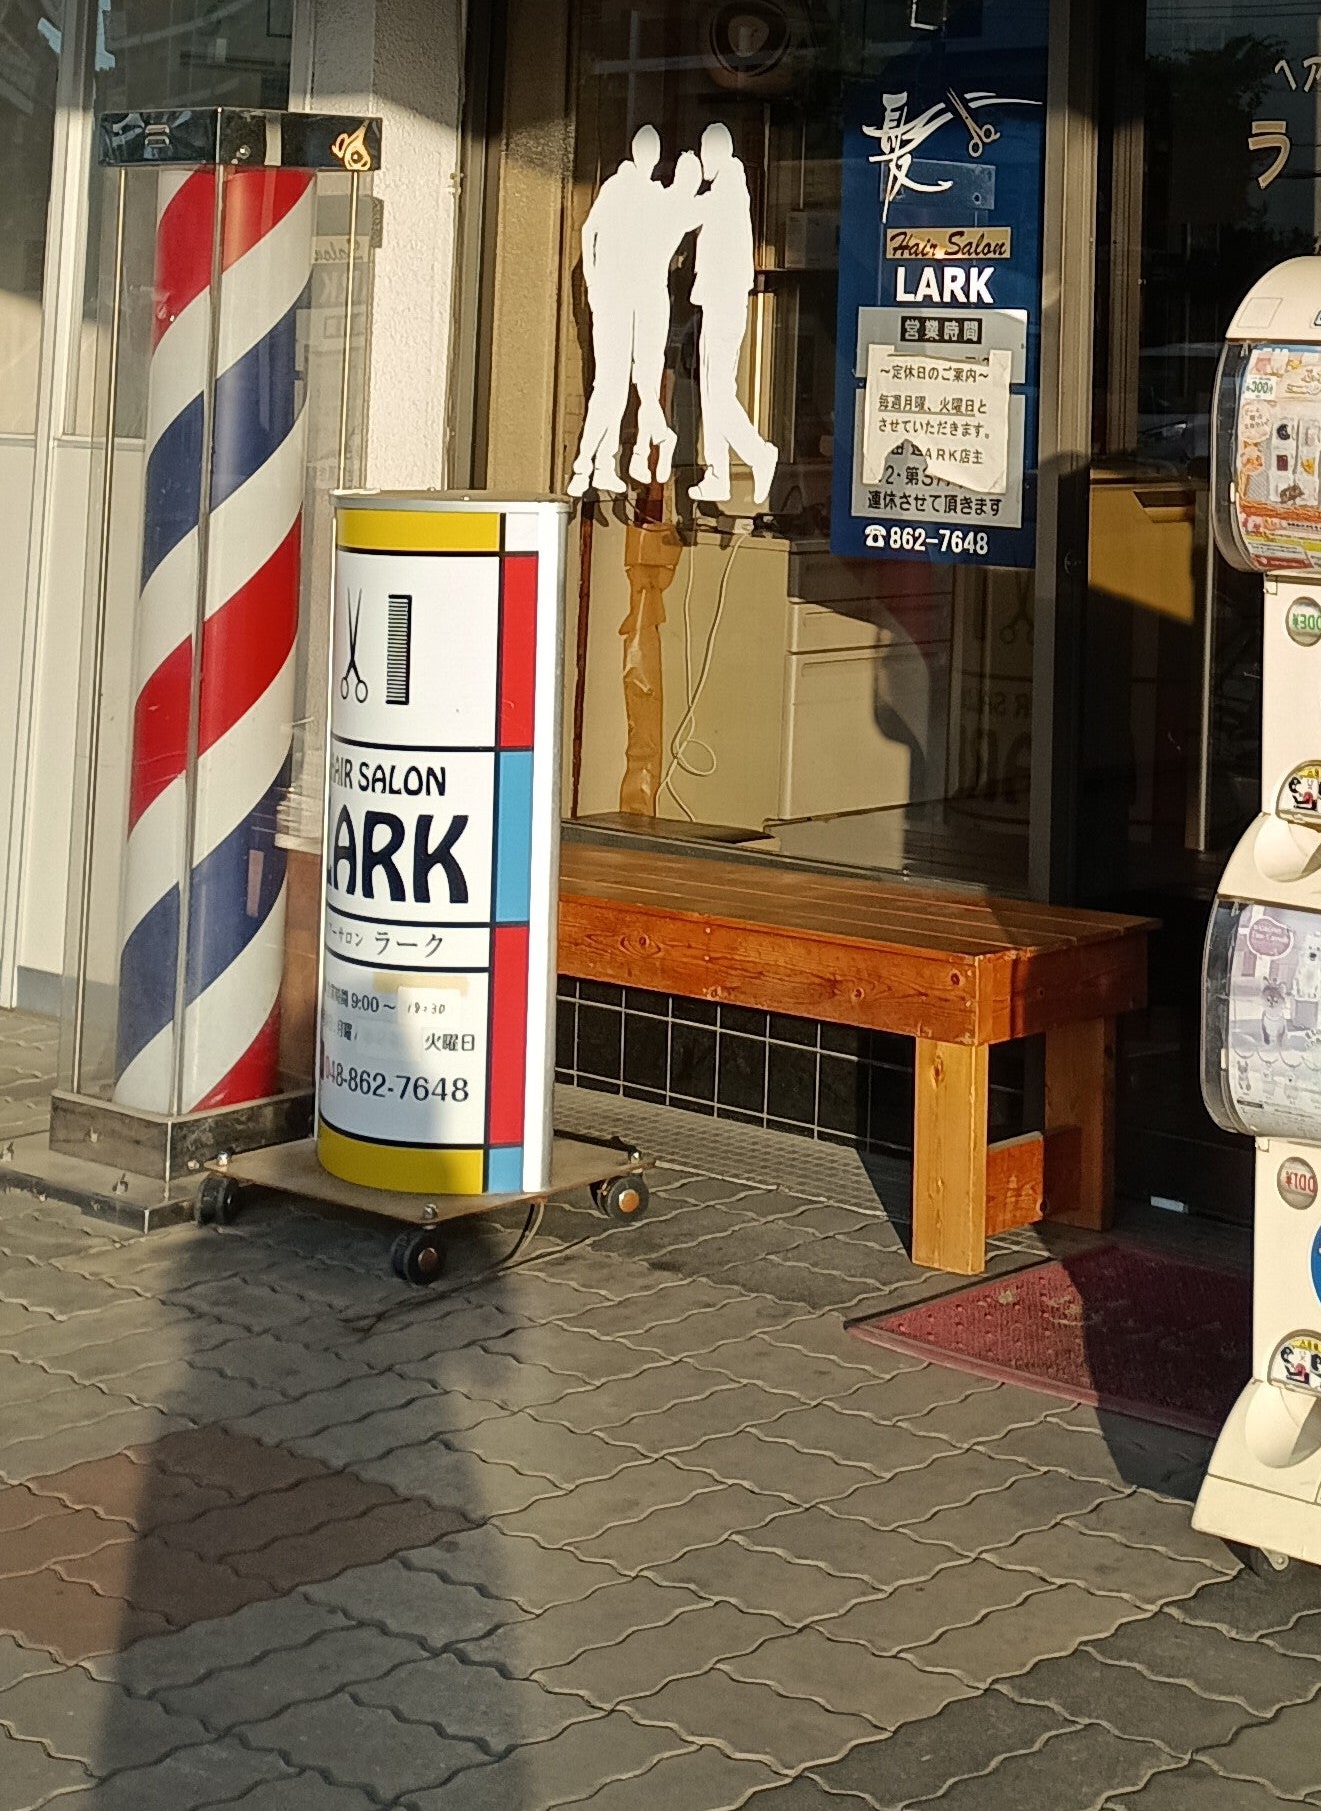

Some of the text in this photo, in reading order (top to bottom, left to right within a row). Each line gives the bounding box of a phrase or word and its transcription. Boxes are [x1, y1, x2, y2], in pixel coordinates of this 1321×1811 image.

[889, 231, 1008, 259] Hair Salon
[895, 266, 995, 305] LARK
[904, 318, 982, 344] 営業時間
[889, 526, 989, 555] 862-7648
[358, 761, 446, 796] SALON
[327, 804, 470, 904] ARK
[375, 931, 443, 959] ラーク
[424, 1033, 475, 1052] 火曜日
